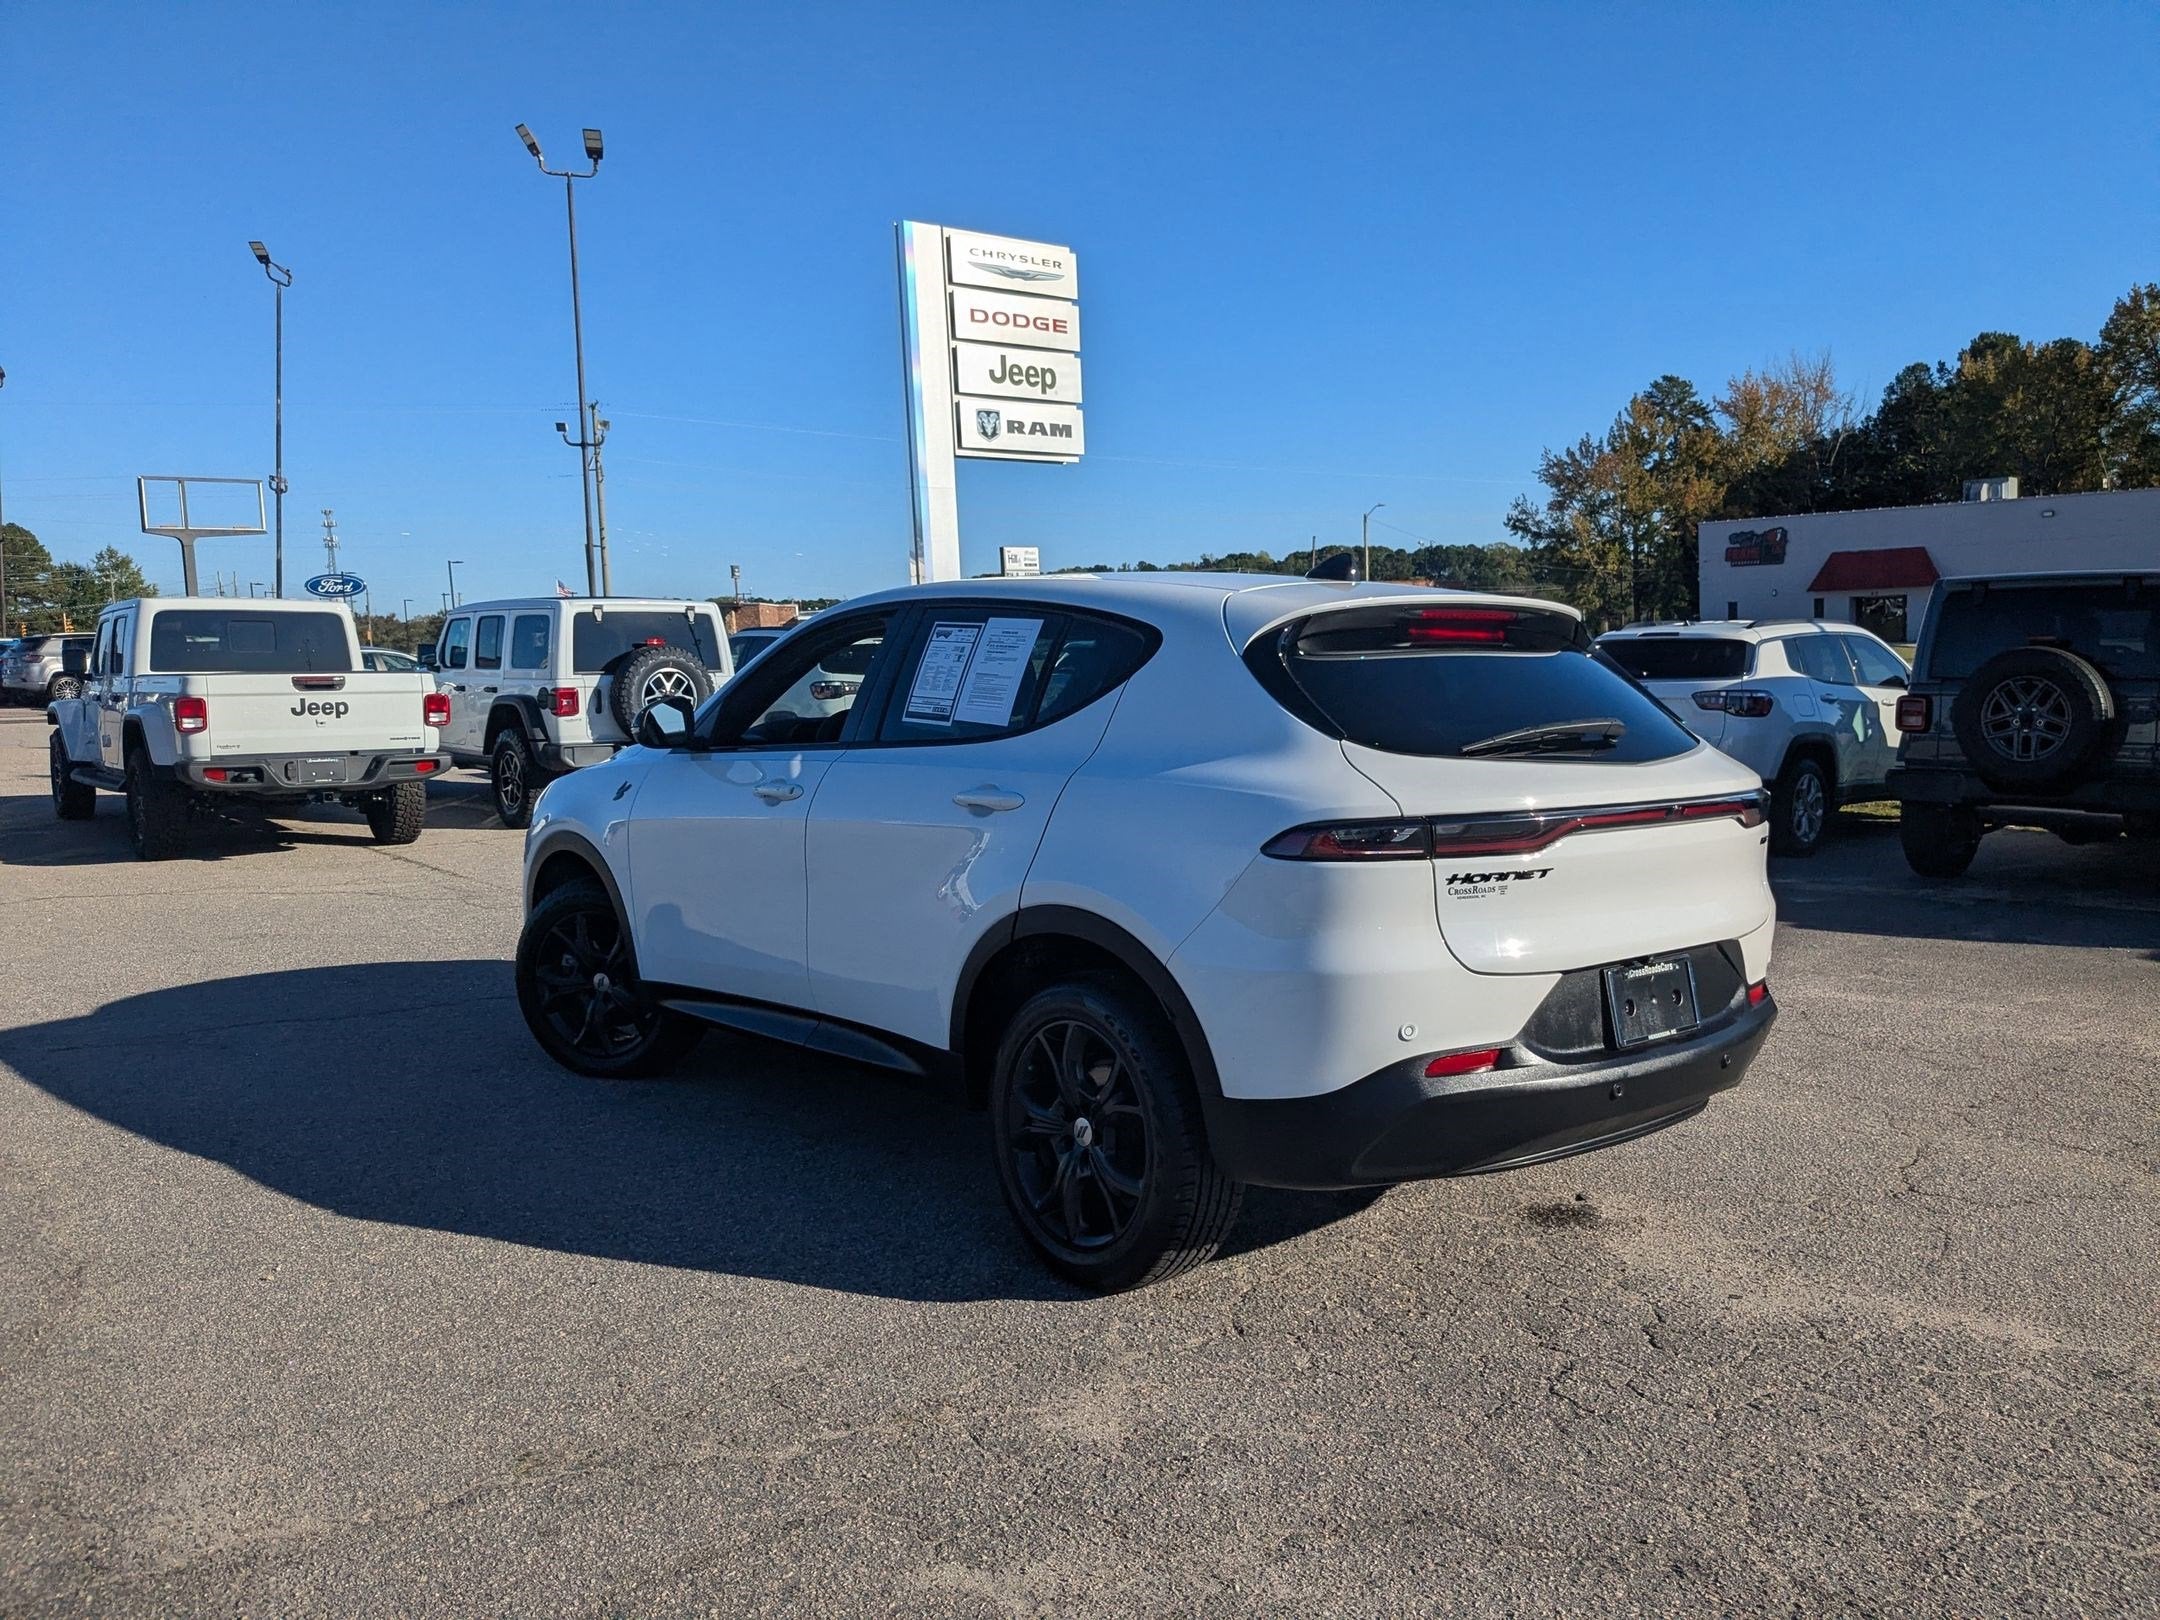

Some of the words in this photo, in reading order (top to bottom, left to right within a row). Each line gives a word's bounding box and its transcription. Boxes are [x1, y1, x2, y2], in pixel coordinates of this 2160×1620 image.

[969, 247, 1063, 270] CHRYSLER
[970, 308, 1068, 335] DODGE
[988, 354, 1057, 395] Jeep
[1006, 419, 1073, 439] RAM
[317, 578, 354, 593] Ford
[290, 697, 349, 719] Jeep
[1445, 867, 1554, 886] HORNET
